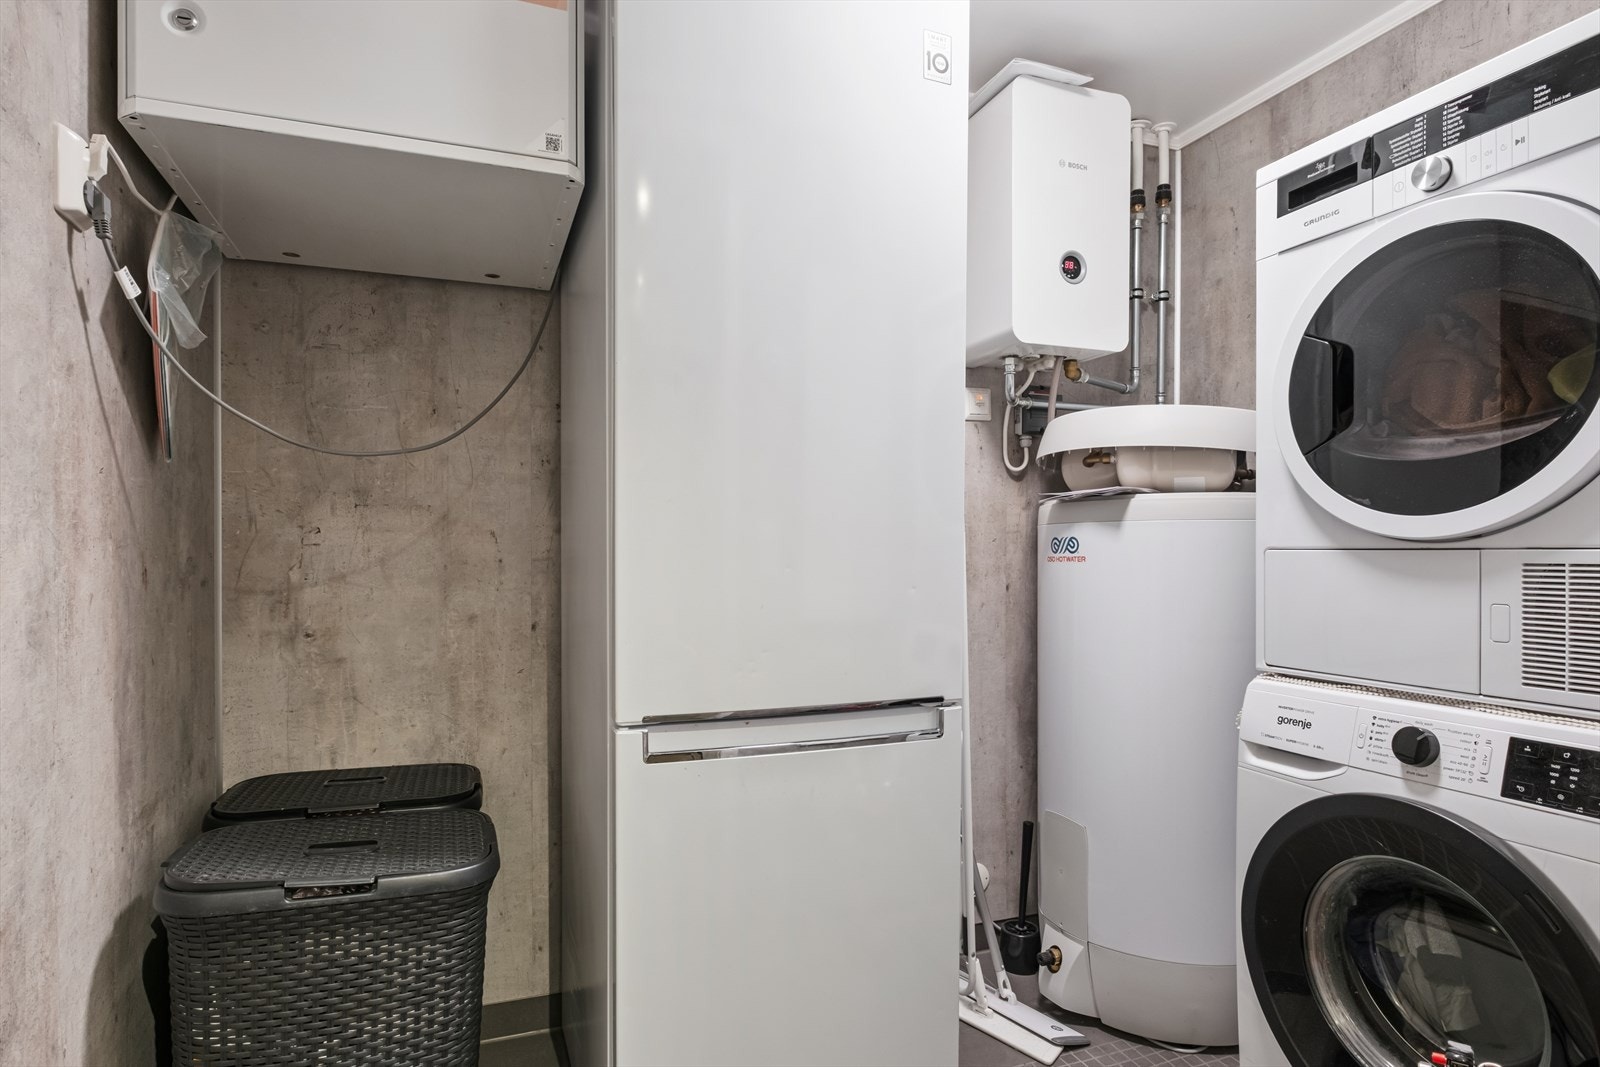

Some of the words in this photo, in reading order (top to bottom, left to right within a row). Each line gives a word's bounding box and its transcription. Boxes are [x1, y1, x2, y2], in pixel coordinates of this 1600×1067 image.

[926, 50, 949, 74] 10
[1067, 161, 1088, 171] BOSCH
[1303, 208, 1340, 227] GRUNDIG
[1277, 715, 1312, 730] gorenje
